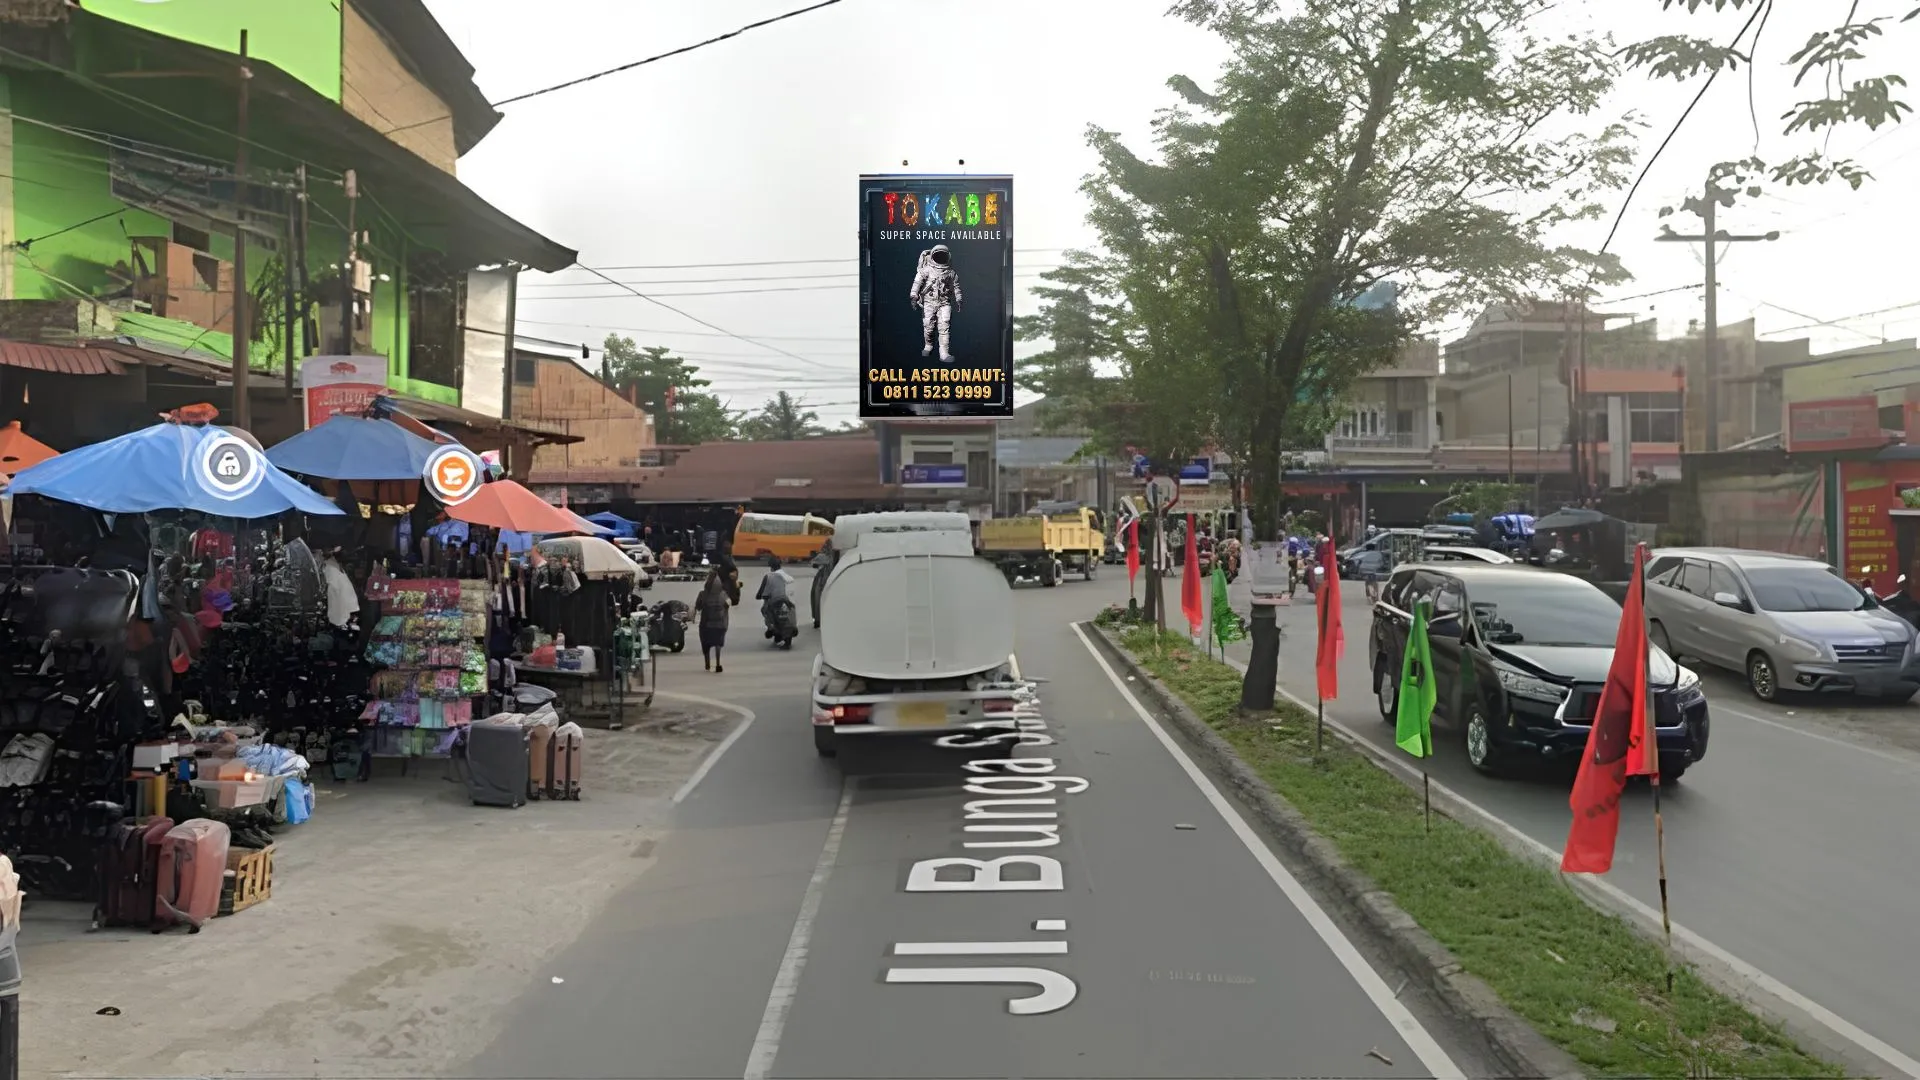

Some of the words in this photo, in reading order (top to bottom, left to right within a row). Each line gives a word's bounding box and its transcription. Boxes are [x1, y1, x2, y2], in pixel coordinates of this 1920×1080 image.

[883, 192, 998, 226] TOKABE
[880, 230, 911, 240] SUPER
[916, 230, 946, 240] SPACE
[951, 230, 1001, 240] AVAILABLE
[868, 368, 906, 382] CALL
[911, 368, 1006, 382] ASTRONAUT:
[883, 385, 918, 399] 0811
[923, 385, 951, 399] 523
[955, 385, 992, 399] 9999
